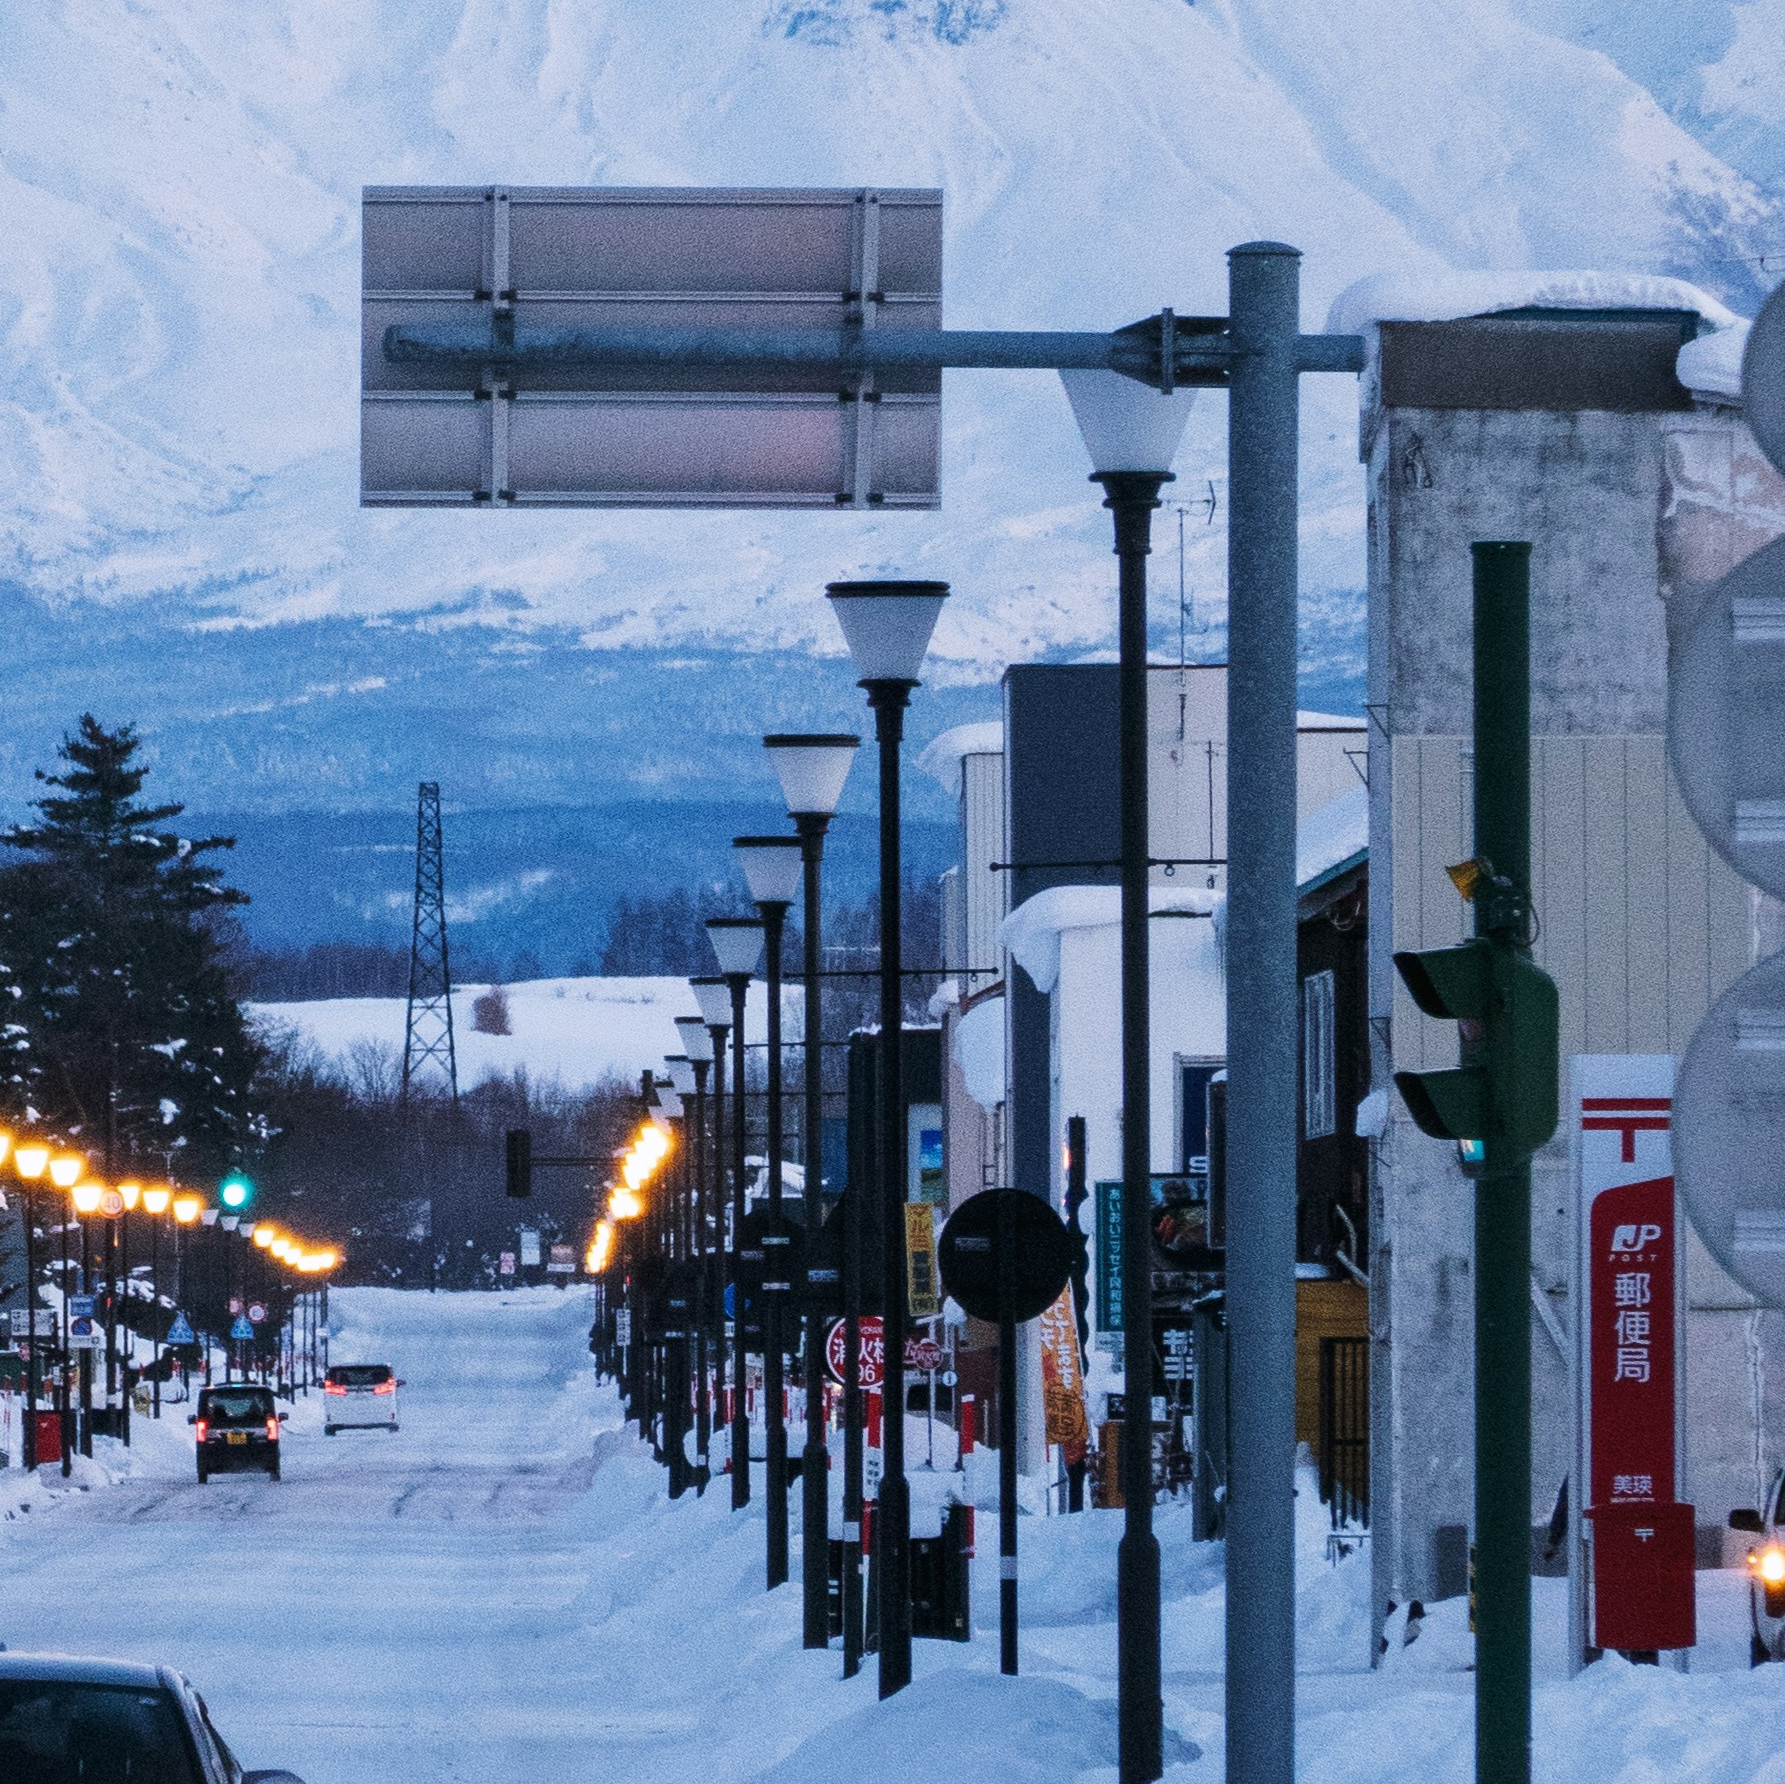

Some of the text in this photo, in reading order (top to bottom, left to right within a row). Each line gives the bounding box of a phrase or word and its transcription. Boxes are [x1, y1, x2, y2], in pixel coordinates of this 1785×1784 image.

[1608, 1254, 1658, 1262] POST
[1614, 1272, 1651, 1383] 郵便局
[1612, 1475, 1652, 1494] 美瑛
